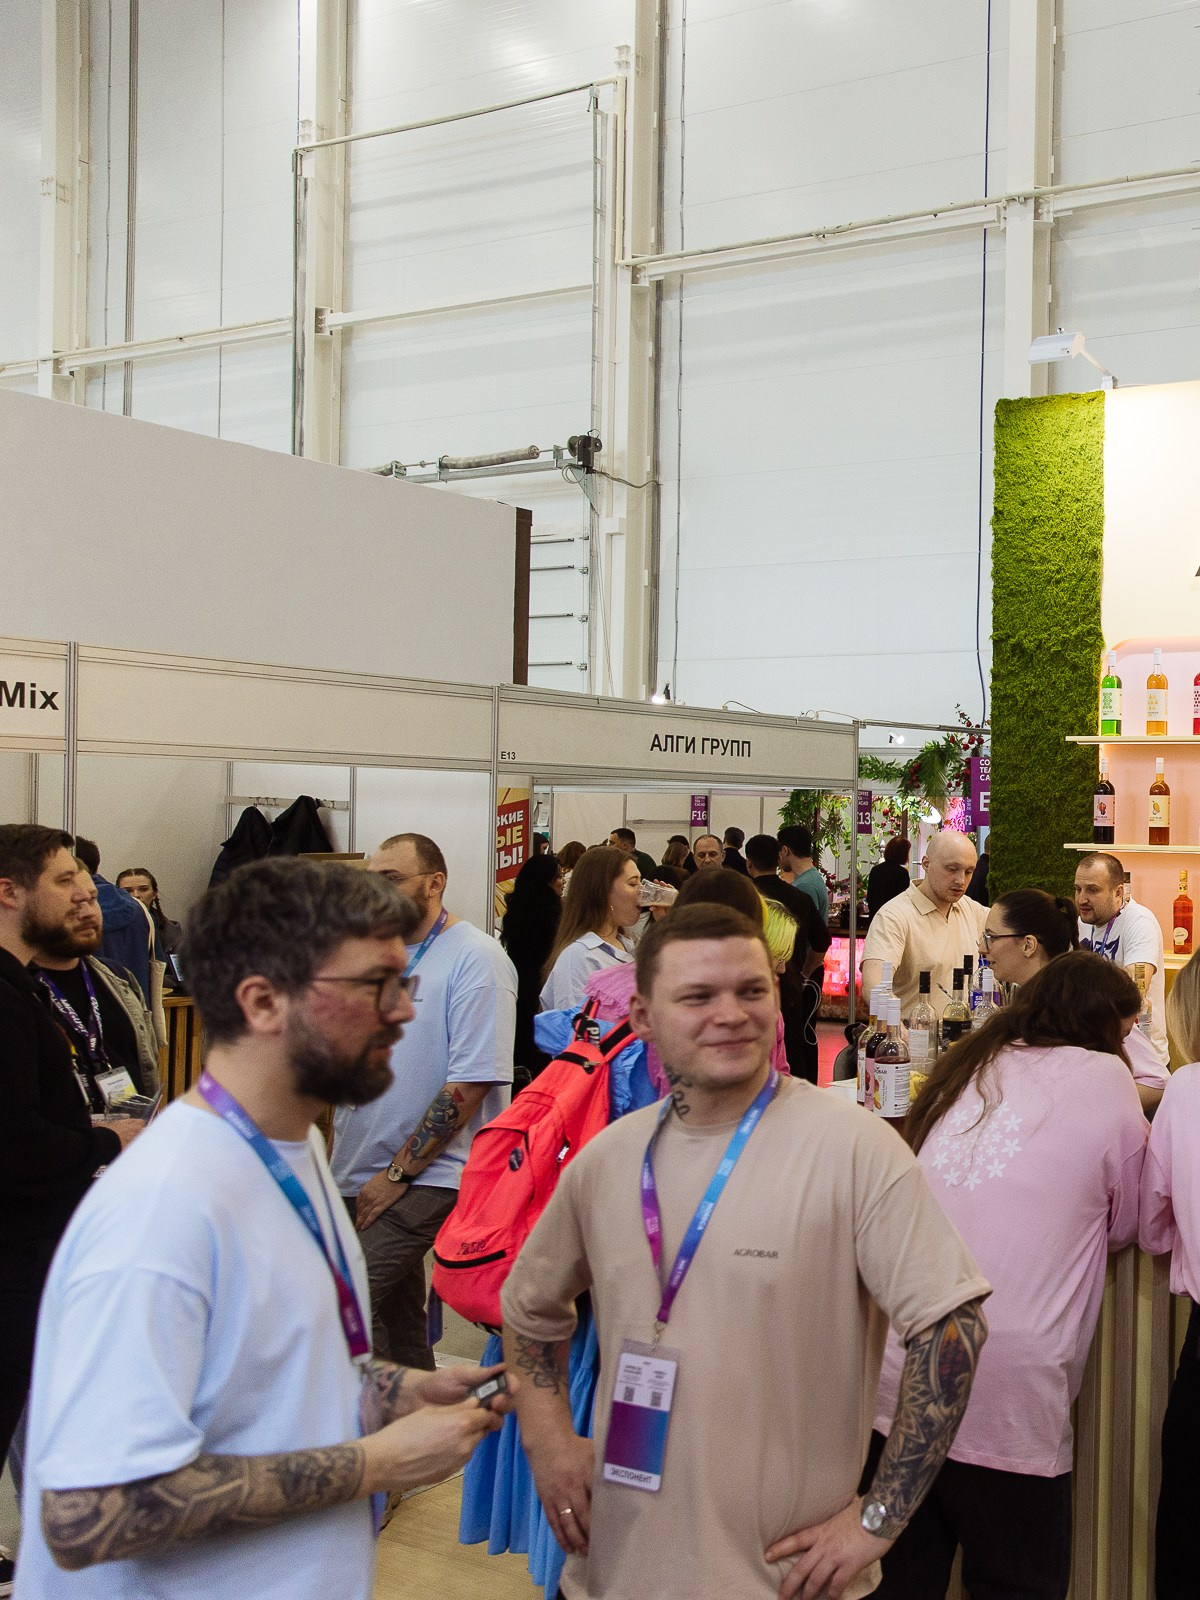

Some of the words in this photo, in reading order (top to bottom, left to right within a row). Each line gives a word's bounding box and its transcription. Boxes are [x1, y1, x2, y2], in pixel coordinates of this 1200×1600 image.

[0, 680, 59, 711] Mix
[650, 733, 696, 754] АЛГИ
[701, 737, 751, 757] ГРУПП
[501, 751, 516, 760] E13
[691, 810, 708, 821] F16
[733, 1248, 779, 1259] AGROBAR
[611, 1467, 653, 1485] ЭКСПОНЕНТ
